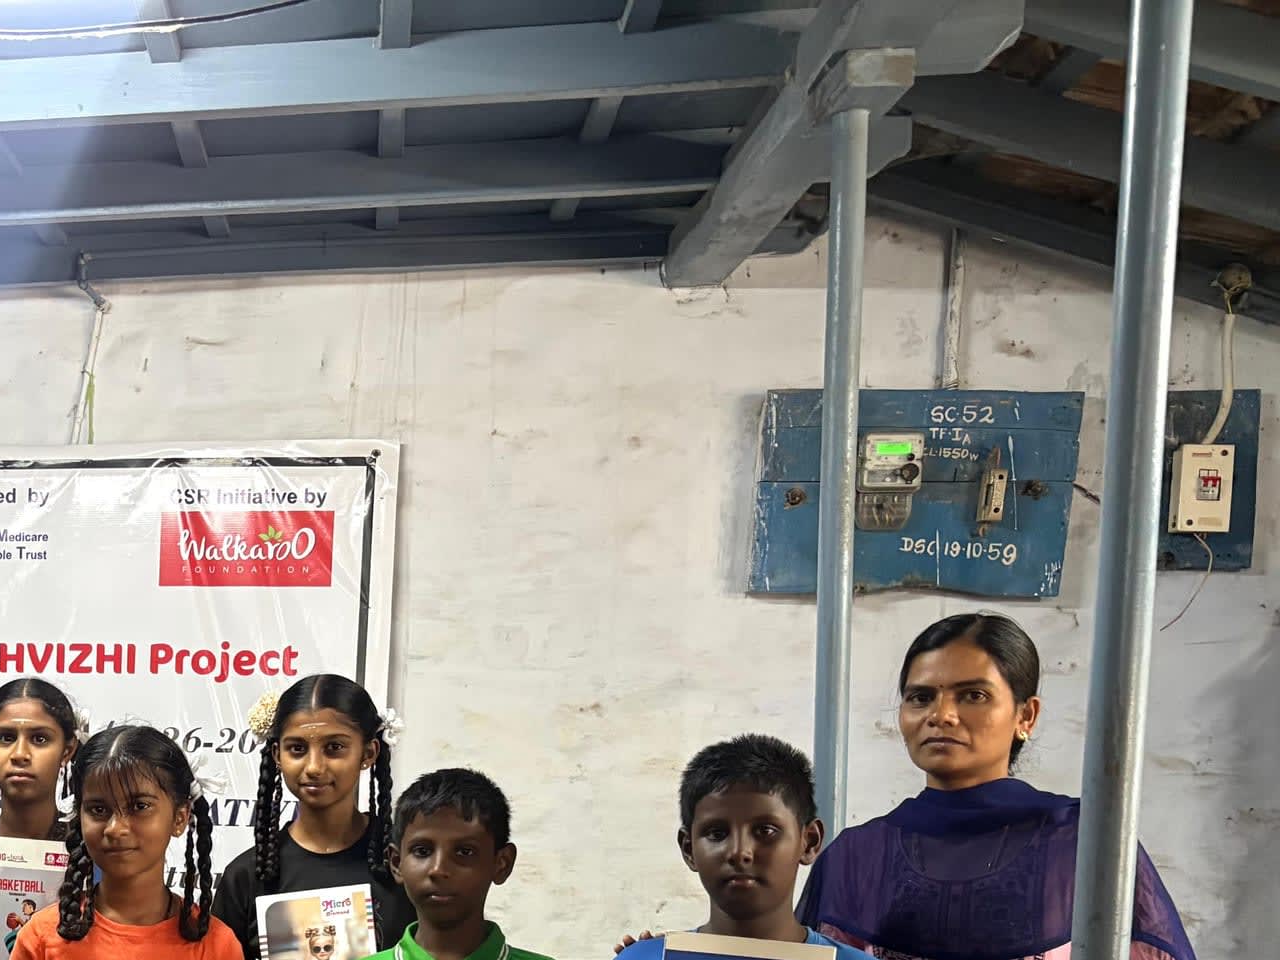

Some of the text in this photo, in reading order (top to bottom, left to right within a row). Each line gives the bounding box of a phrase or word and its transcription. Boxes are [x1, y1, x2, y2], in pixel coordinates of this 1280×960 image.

[28, 488, 50, 507] by
[216, 488, 298, 504] Initiative
[304, 488, 328, 508] by
[16, 546, 48, 560] Trust
[900, 537, 937, 556] DSC
[182, 565, 310, 574] FOUNDATION
[149, 641, 299, 683] Project
